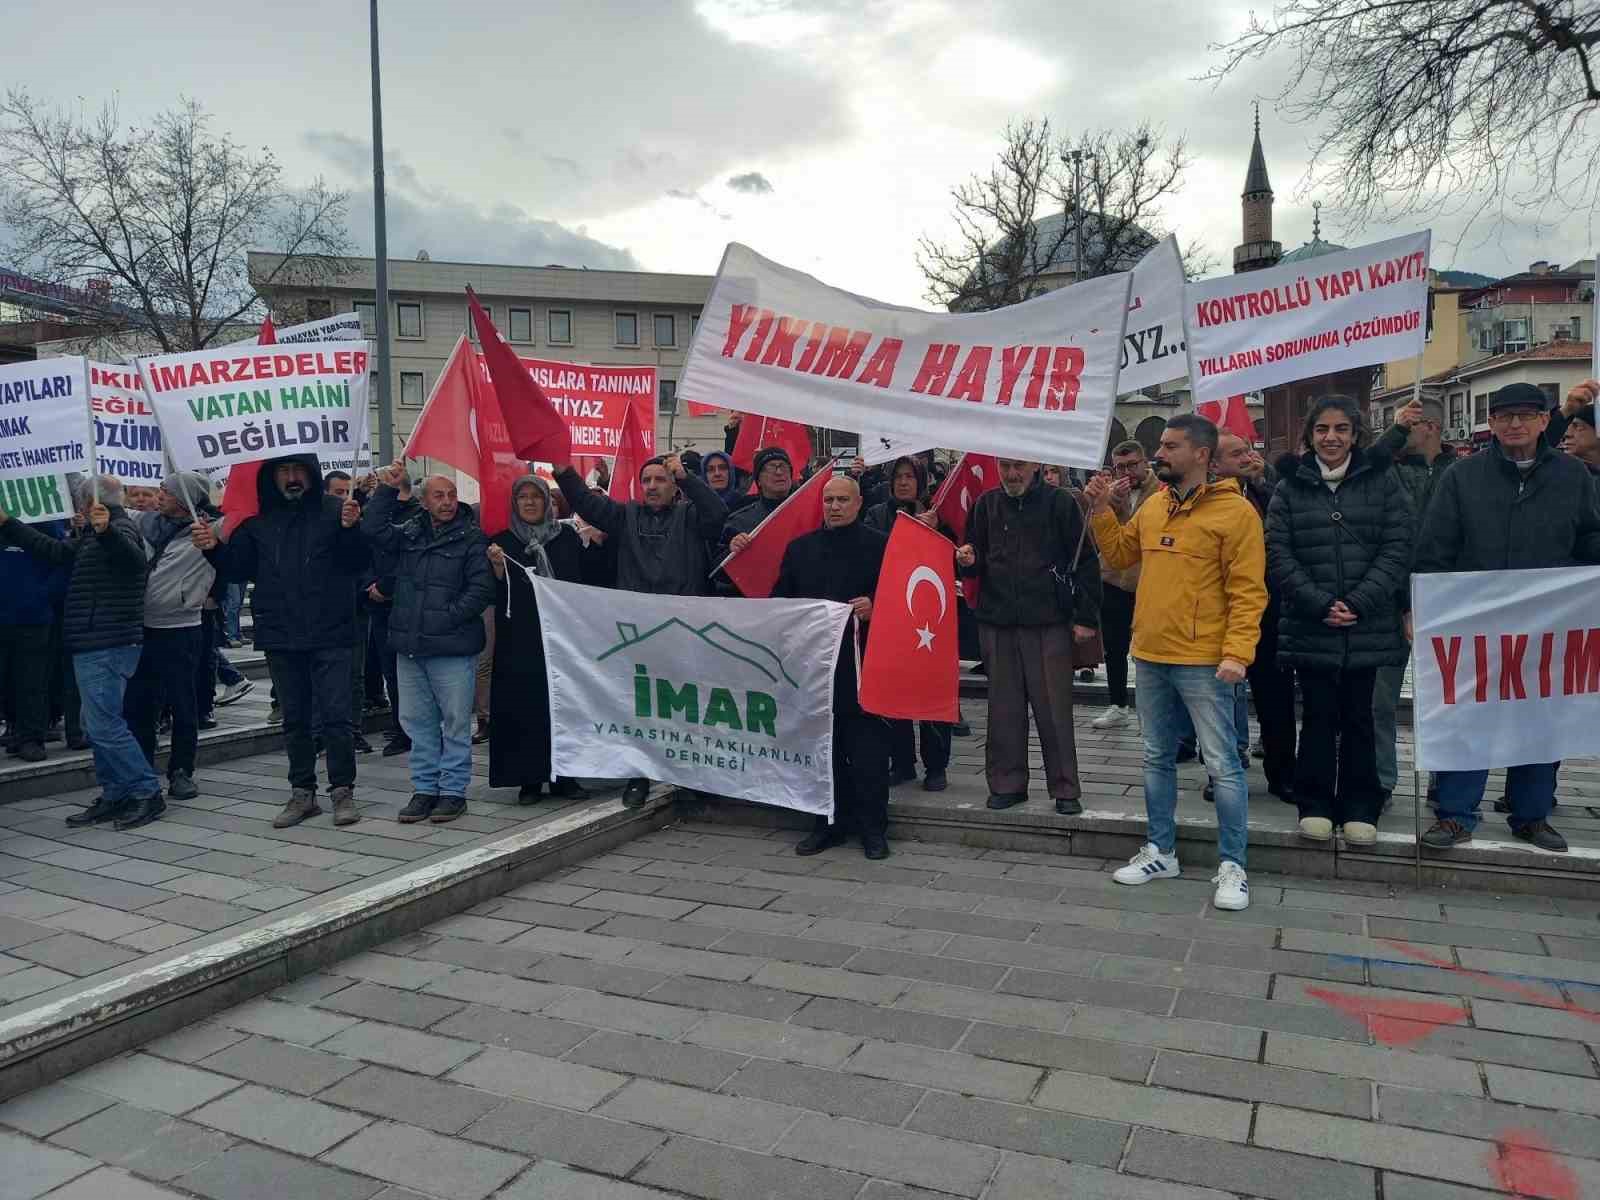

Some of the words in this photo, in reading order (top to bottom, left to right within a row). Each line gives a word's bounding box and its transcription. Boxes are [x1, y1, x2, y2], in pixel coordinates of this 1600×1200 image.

[1197, 276, 1311, 328] KONTROLLÜ
[1315, 269, 1364, 301] YAPI
[1367, 251, 1427, 289] KAYIT,
[721, 303, 904, 389] YIKIMA
[909, 343, 1085, 412] HAYIR
[1198, 348, 1263, 377] YILLARIN
[1266, 331, 1340, 363] SORUNUNA
[1343, 311, 1421, 348] ÇÖZÜMDÜR
[149, 352, 369, 393] İMARZEDELER
[590, 374, 652, 394] TANINAN
[91, 395, 153, 415] EĞİL
[187, 389, 272, 422] VATAN
[279, 379, 350, 410] HAİNİ
[22, 440, 84, 468] İHANETTİR
[197, 415, 350, 459] DEĞİLDİR
[634, 664, 777, 738] İMAR
[594, 723, 694, 745] YASASINA
[704, 736, 814, 767] TAKILANLAR
[666, 748, 746, 772] DERNEĞİ
